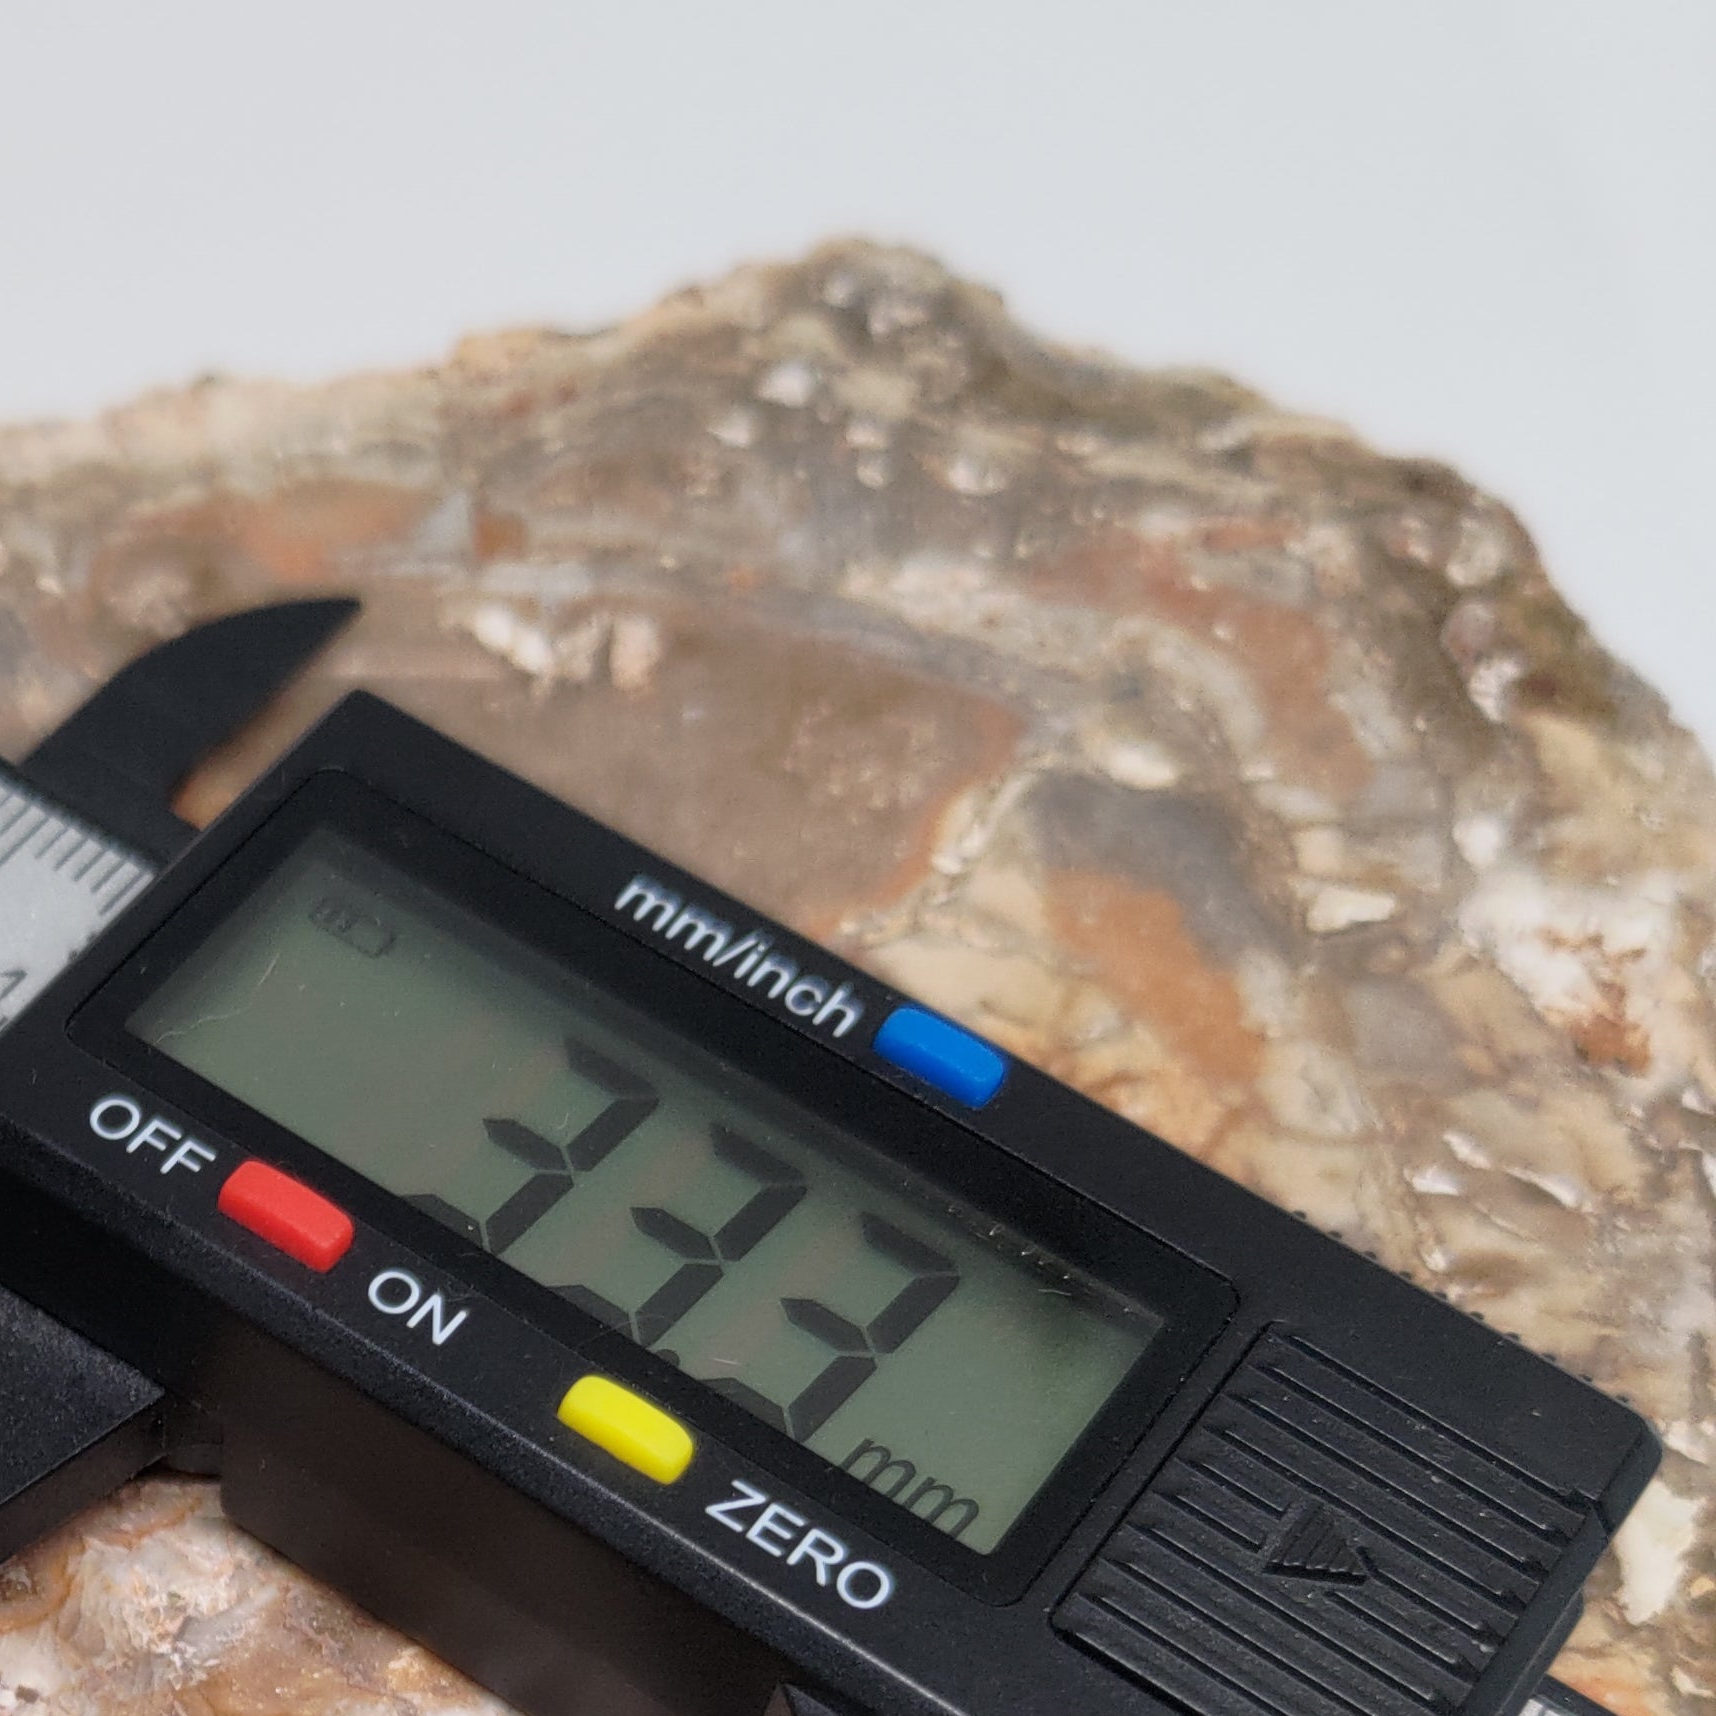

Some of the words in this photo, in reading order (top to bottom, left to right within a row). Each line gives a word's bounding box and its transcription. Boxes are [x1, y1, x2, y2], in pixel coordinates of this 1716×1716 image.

[614, 874, 861, 1038] mm/inch
[88, 1093, 216, 1176] OFF
[367, 1269, 470, 1346] ON
[839, 1437, 980, 1537] mm
[704, 1478, 895, 1612] ZERO
